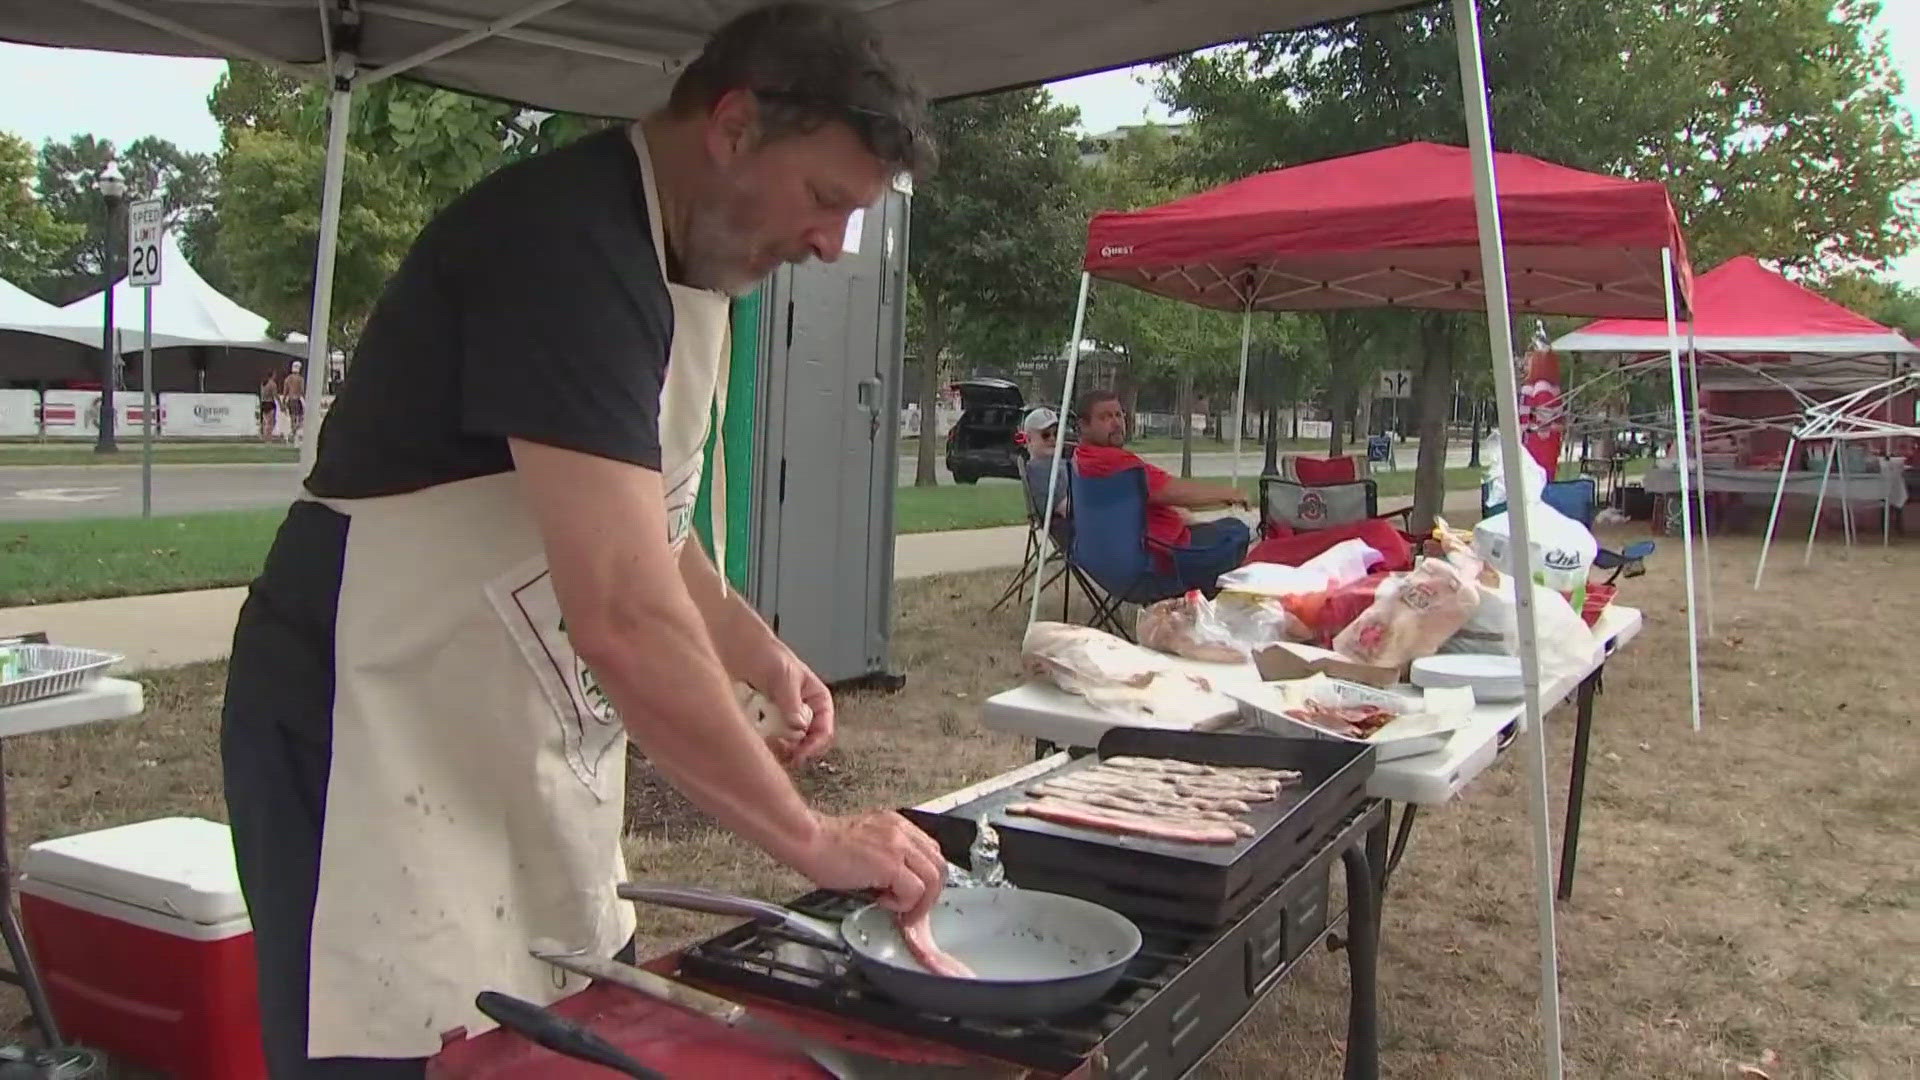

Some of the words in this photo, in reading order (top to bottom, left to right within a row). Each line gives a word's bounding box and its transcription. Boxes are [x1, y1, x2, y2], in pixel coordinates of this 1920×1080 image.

[133, 209, 159, 224] SPEED
[134, 227, 156, 242] LIMIT
[1101, 245, 1134, 258] QUEST
[133, 245, 159, 276] 20
